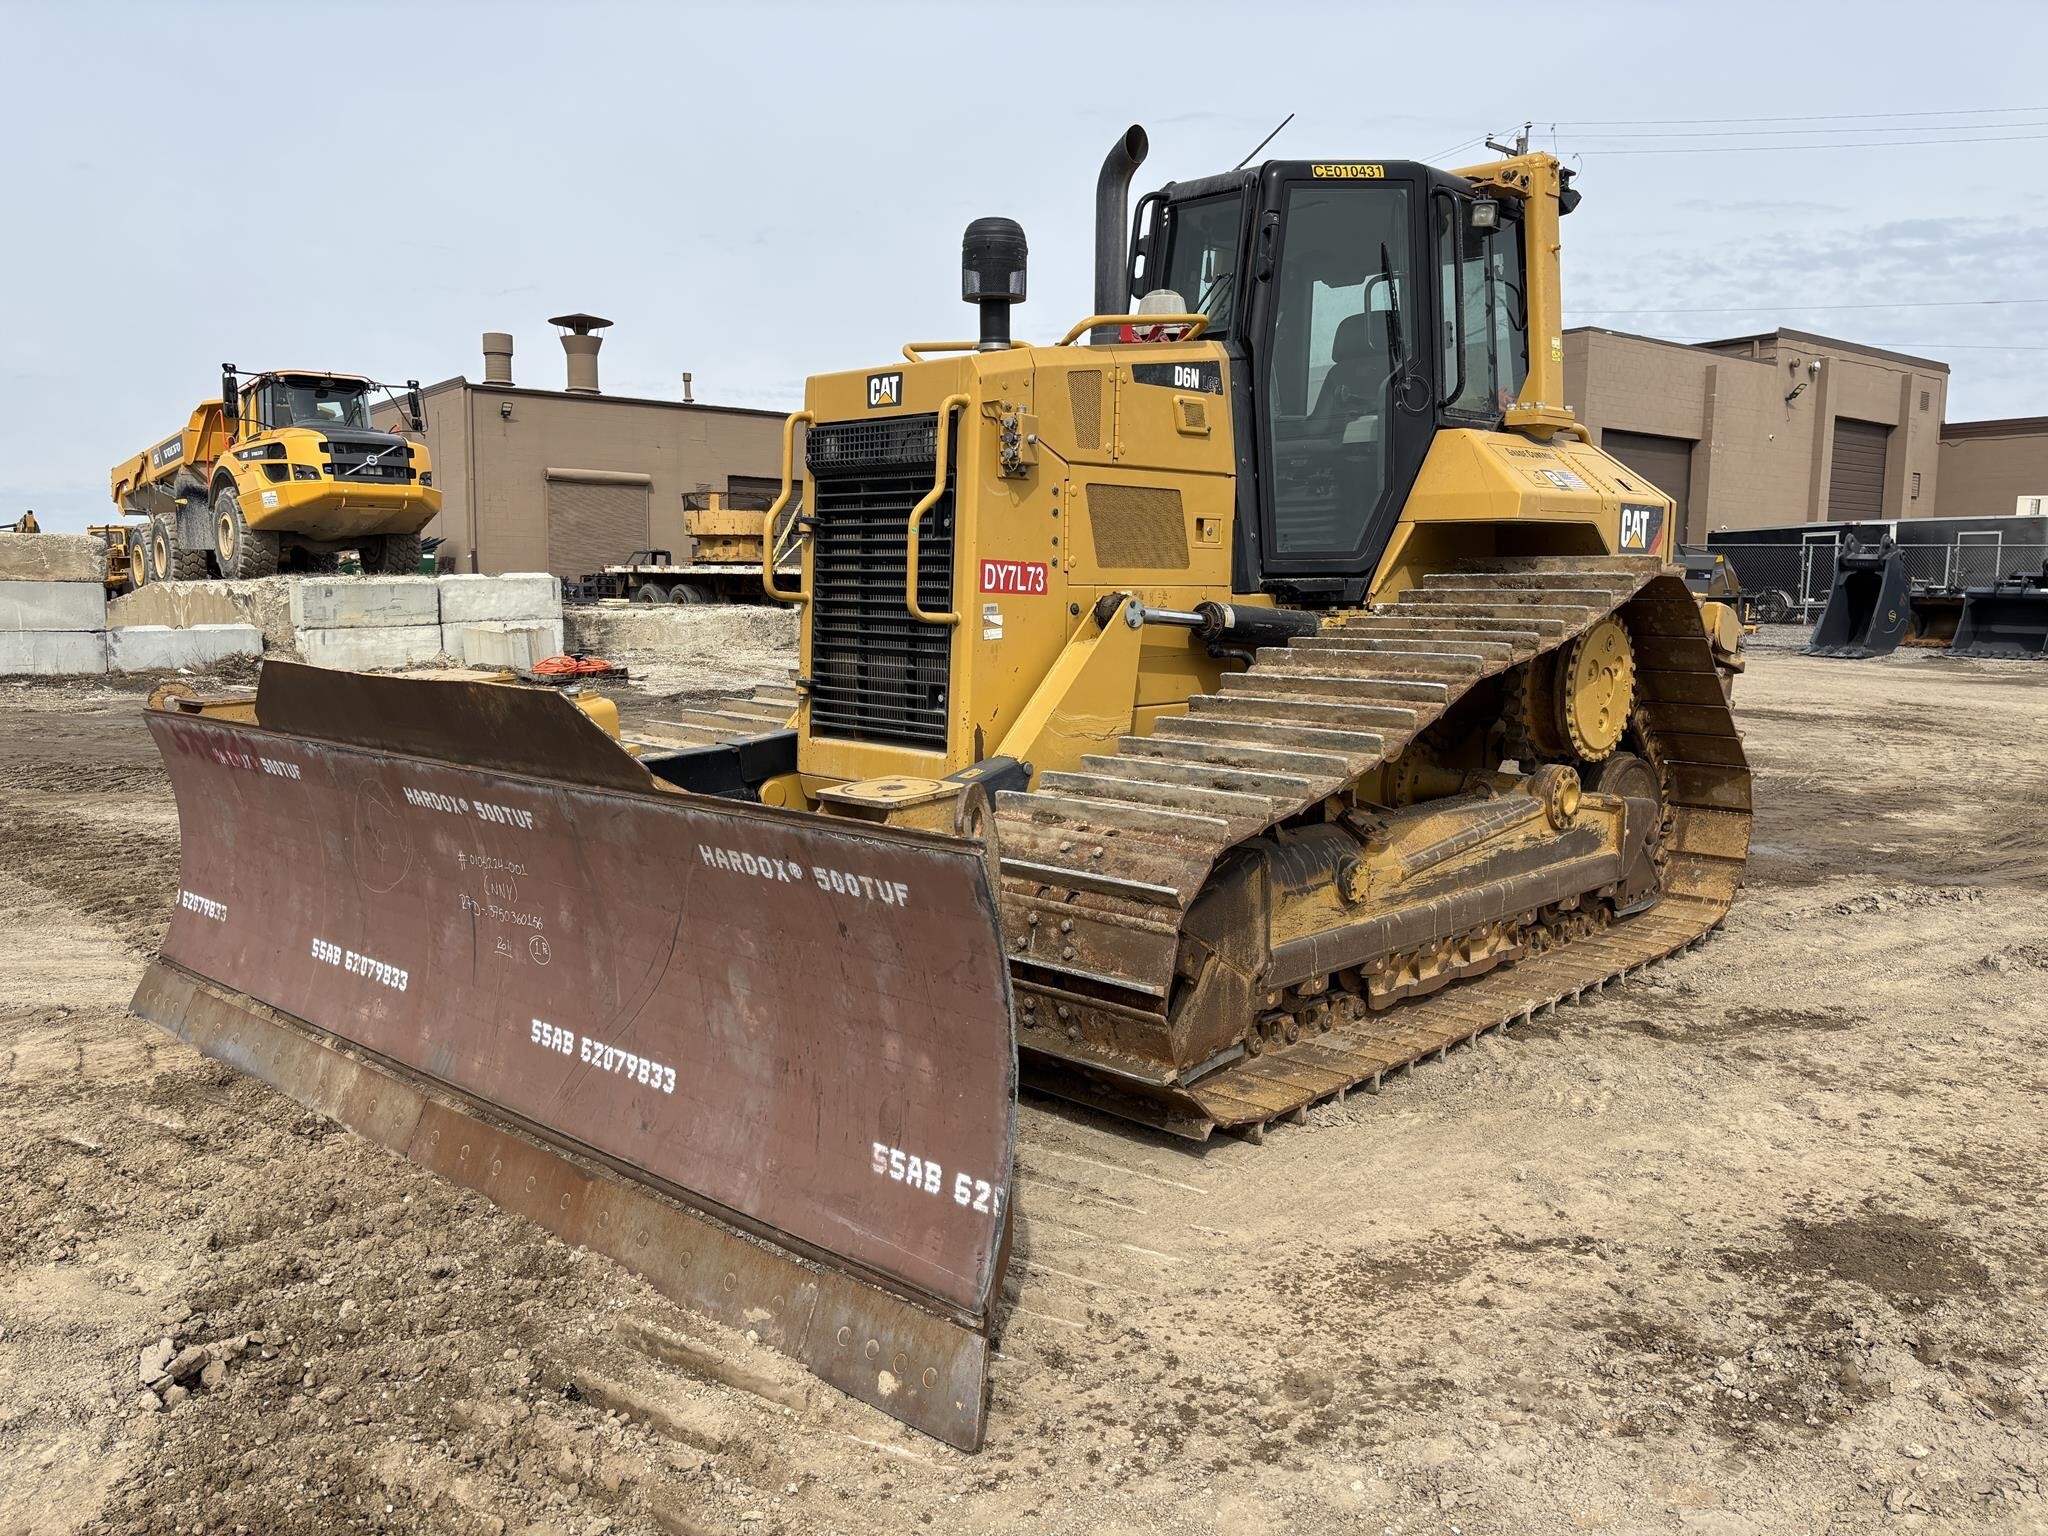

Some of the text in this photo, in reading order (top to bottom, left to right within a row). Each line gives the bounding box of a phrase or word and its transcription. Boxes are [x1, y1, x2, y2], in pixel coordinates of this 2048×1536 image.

[1313, 165, 1382, 177] CE010431
[870, 375, 899, 405] CAT
[1174, 365, 1200, 388] D6N
[1621, 508, 1650, 549] CAT
[984, 563, 1044, 592] DY7L73
[259, 757, 301, 781] 500TUF
[473, 800, 533, 830] 500TUF
[811, 866, 909, 907] 500TUF
[182, 890, 228, 922] 62079833
[311, 938, 409, 992] SSAB 62079833
[531, 1019, 677, 1094] SSAB 62079833
[872, 1142, 942, 1195] SSAB
